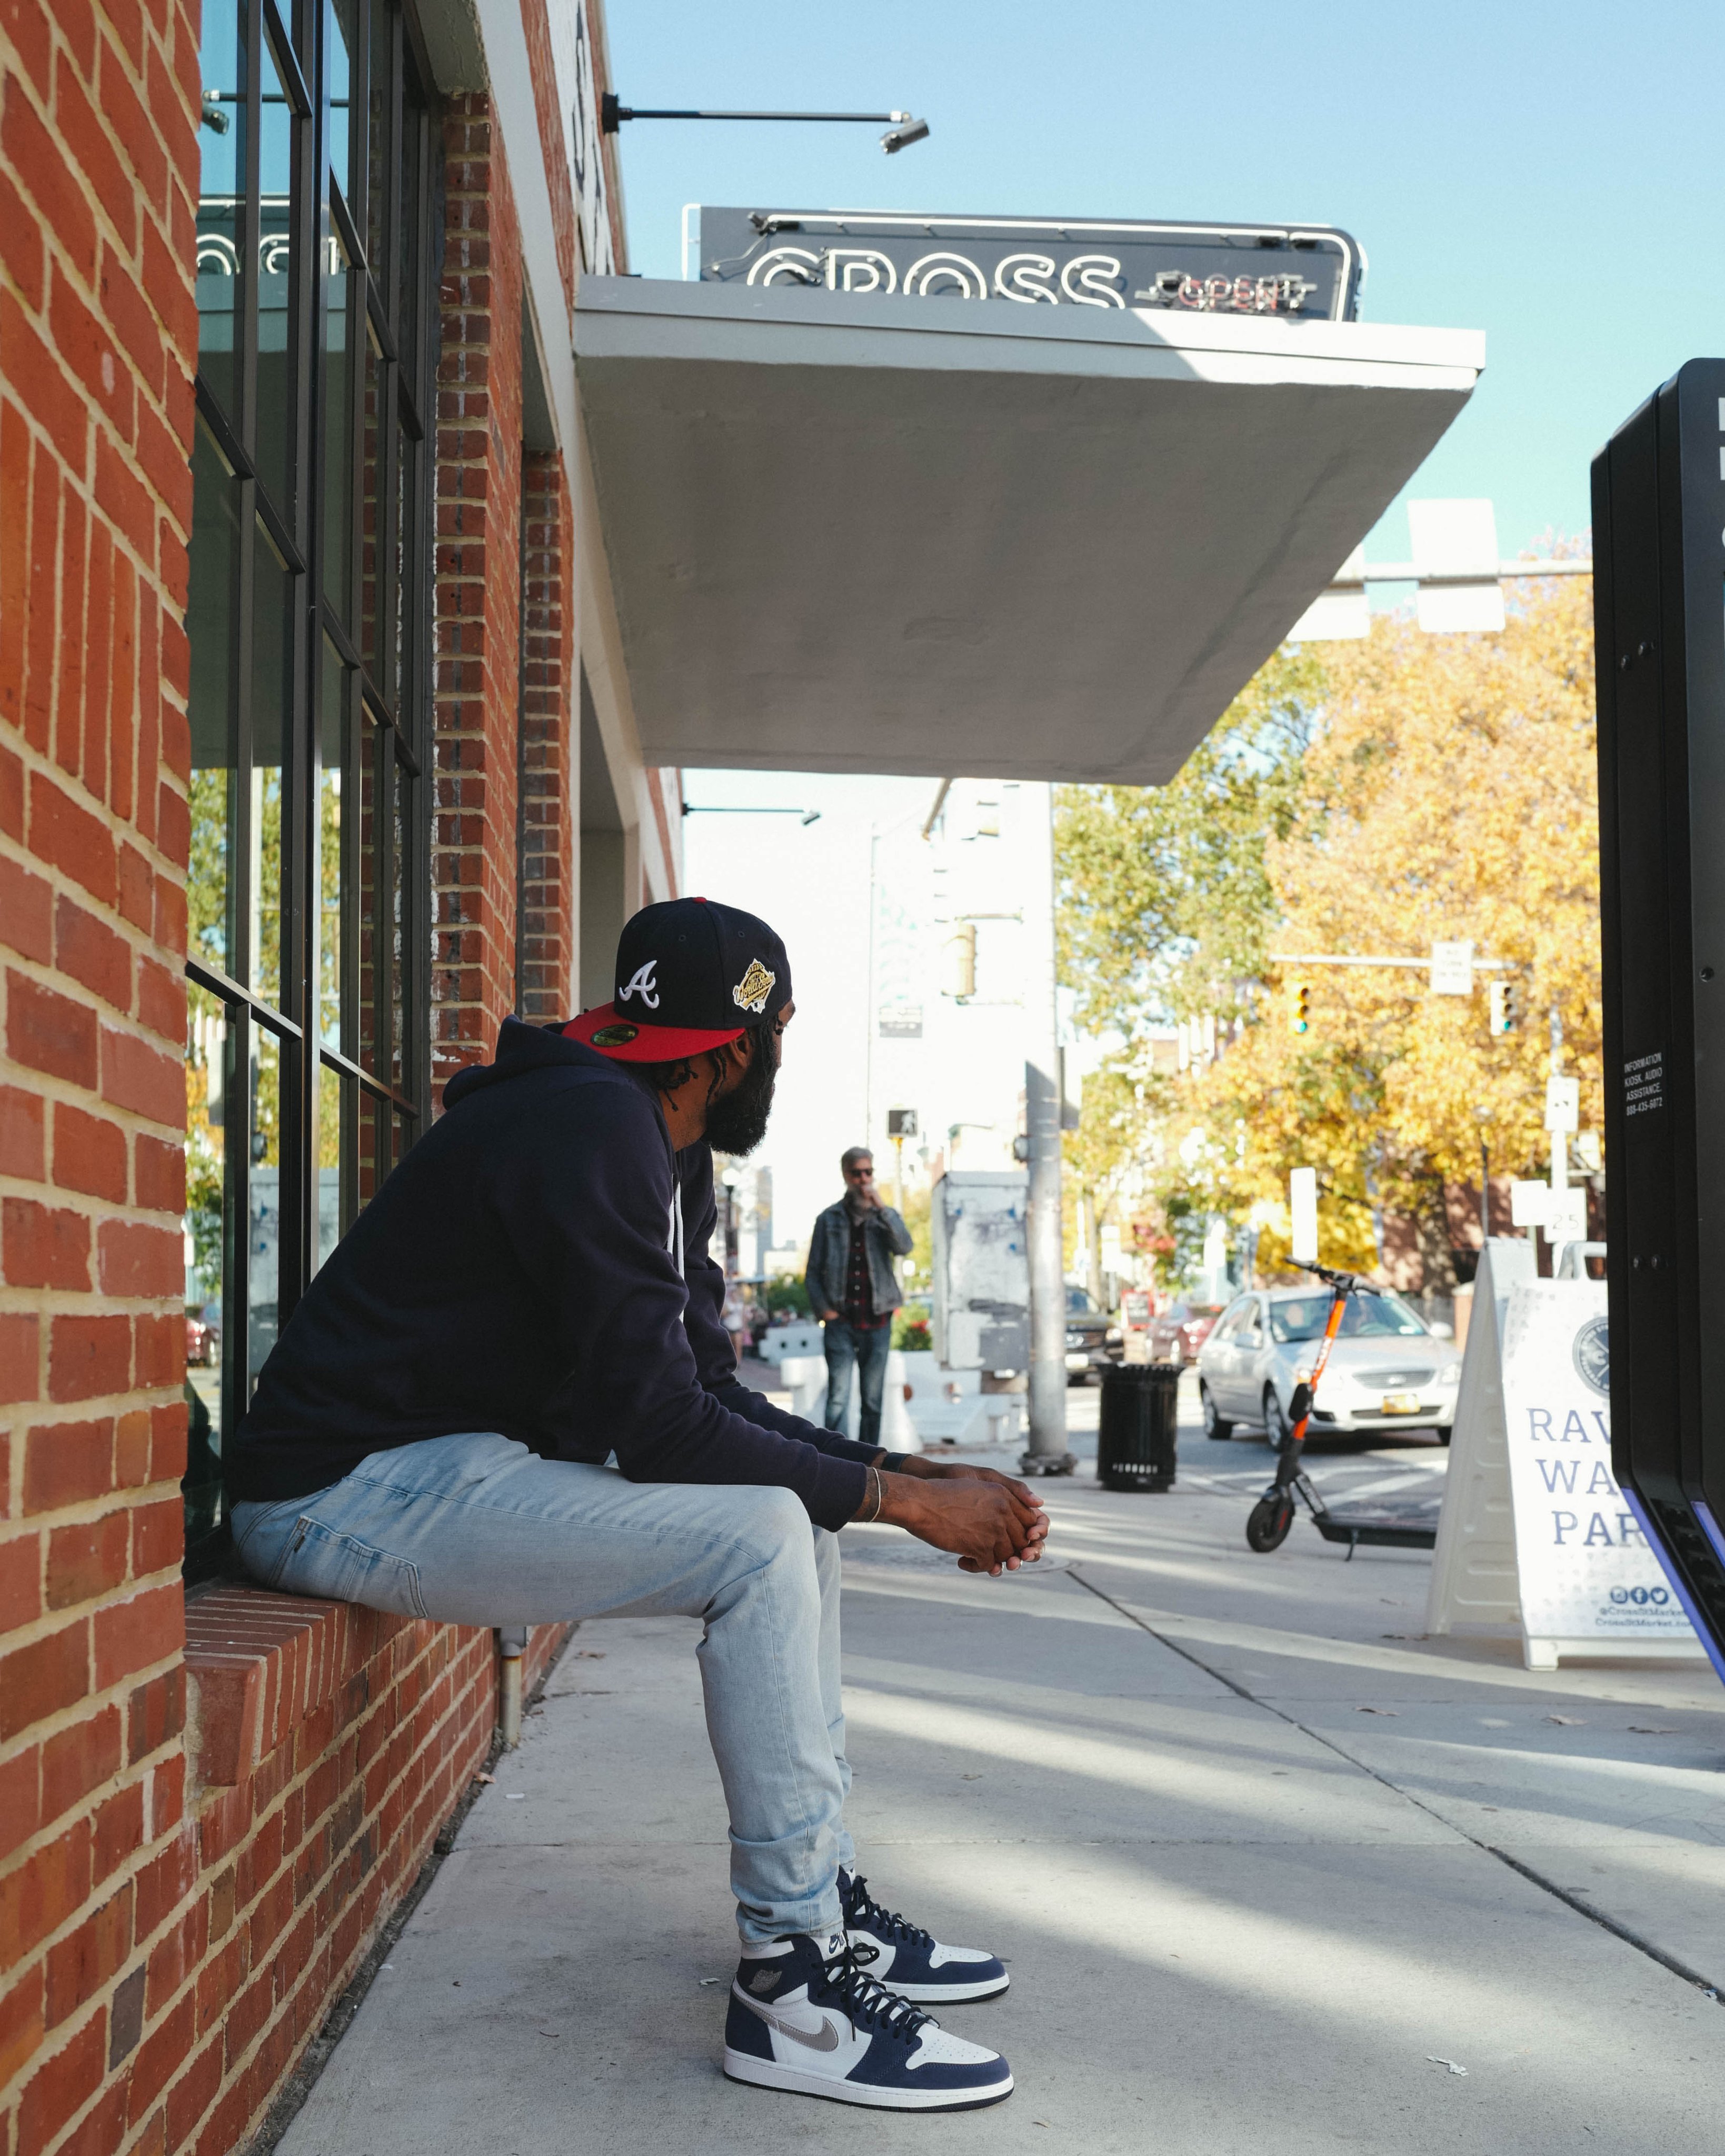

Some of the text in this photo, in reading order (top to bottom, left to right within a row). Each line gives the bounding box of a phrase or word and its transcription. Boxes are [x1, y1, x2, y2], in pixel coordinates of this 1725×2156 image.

[619, 960, 660, 1009] A
[1624, 1053, 1662, 1073] INFORMATION
[1646, 1067, 1662, 1081] AUDIO
[1552, 1214, 1579, 1230] 25
